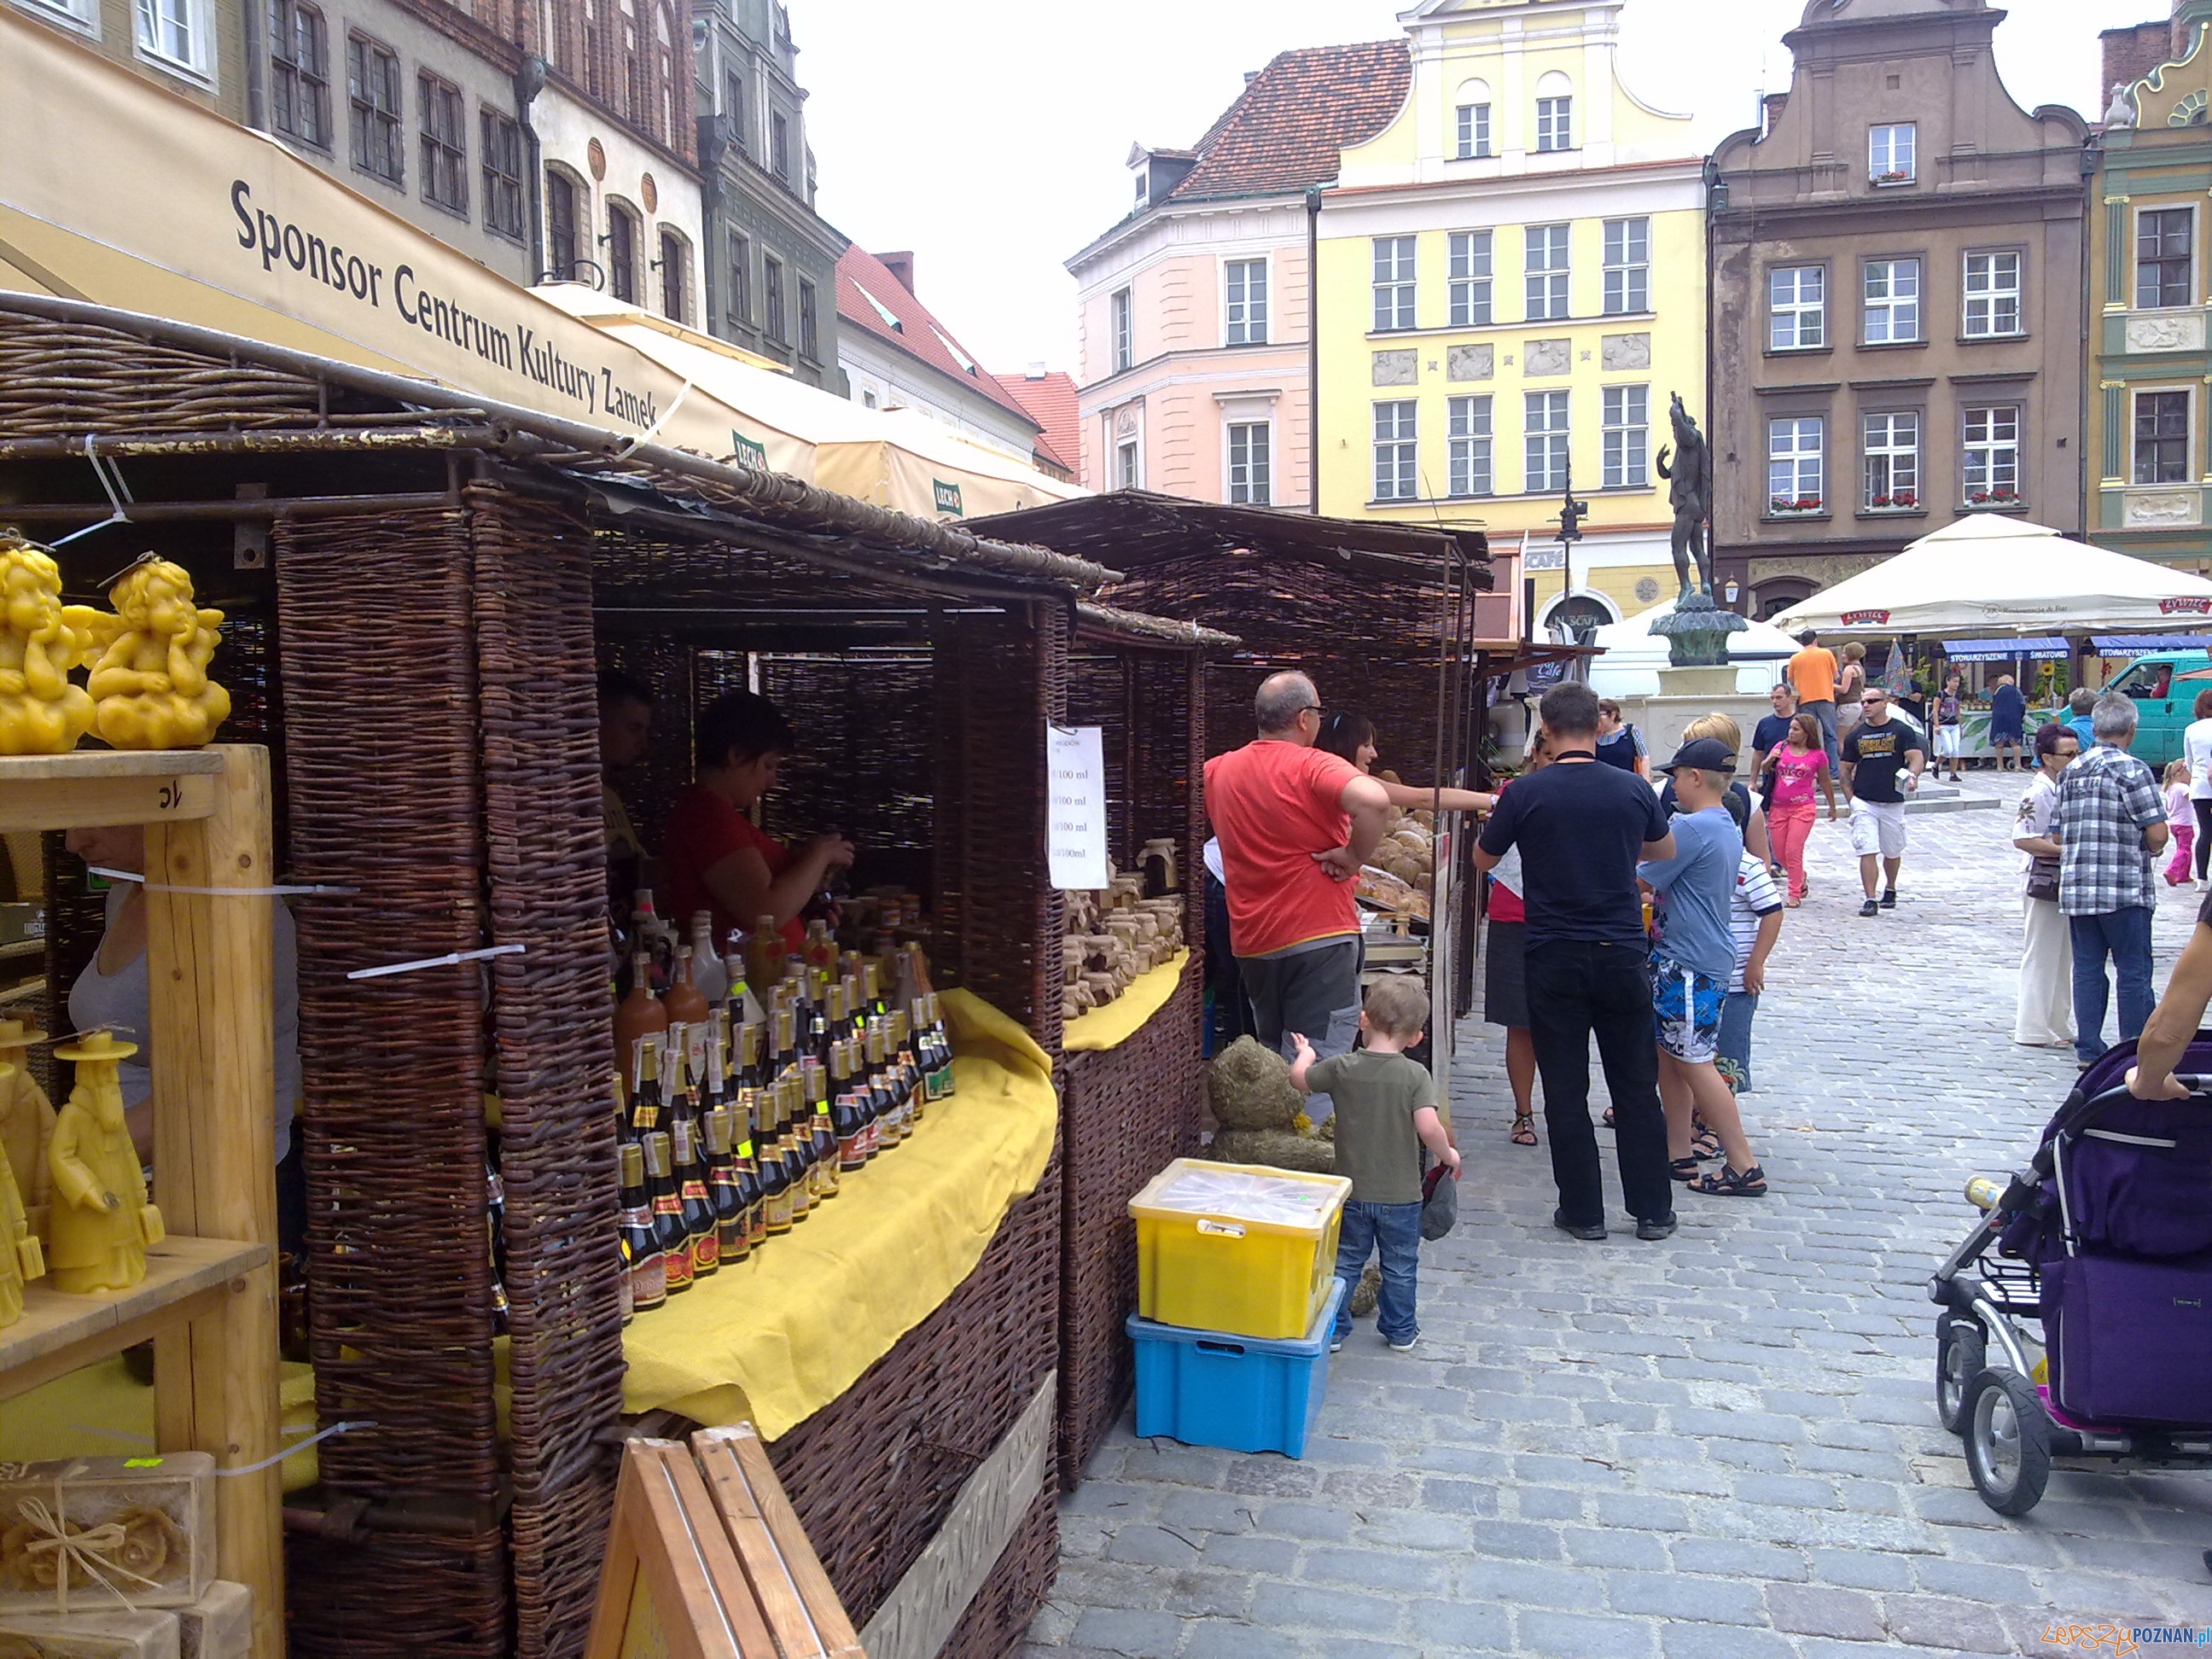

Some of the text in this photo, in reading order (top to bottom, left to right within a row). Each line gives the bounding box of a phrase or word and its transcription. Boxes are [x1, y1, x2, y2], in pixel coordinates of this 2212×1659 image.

[230, 179, 661, 435] Sponsor Centrum Kultury Zamek
[736, 439, 760, 470] LECH
[935, 485, 953, 507] LECH
[1076, 770, 1088, 779] ml
[1074, 796, 1086, 806] ml
[1075, 822, 1087, 831] ml
